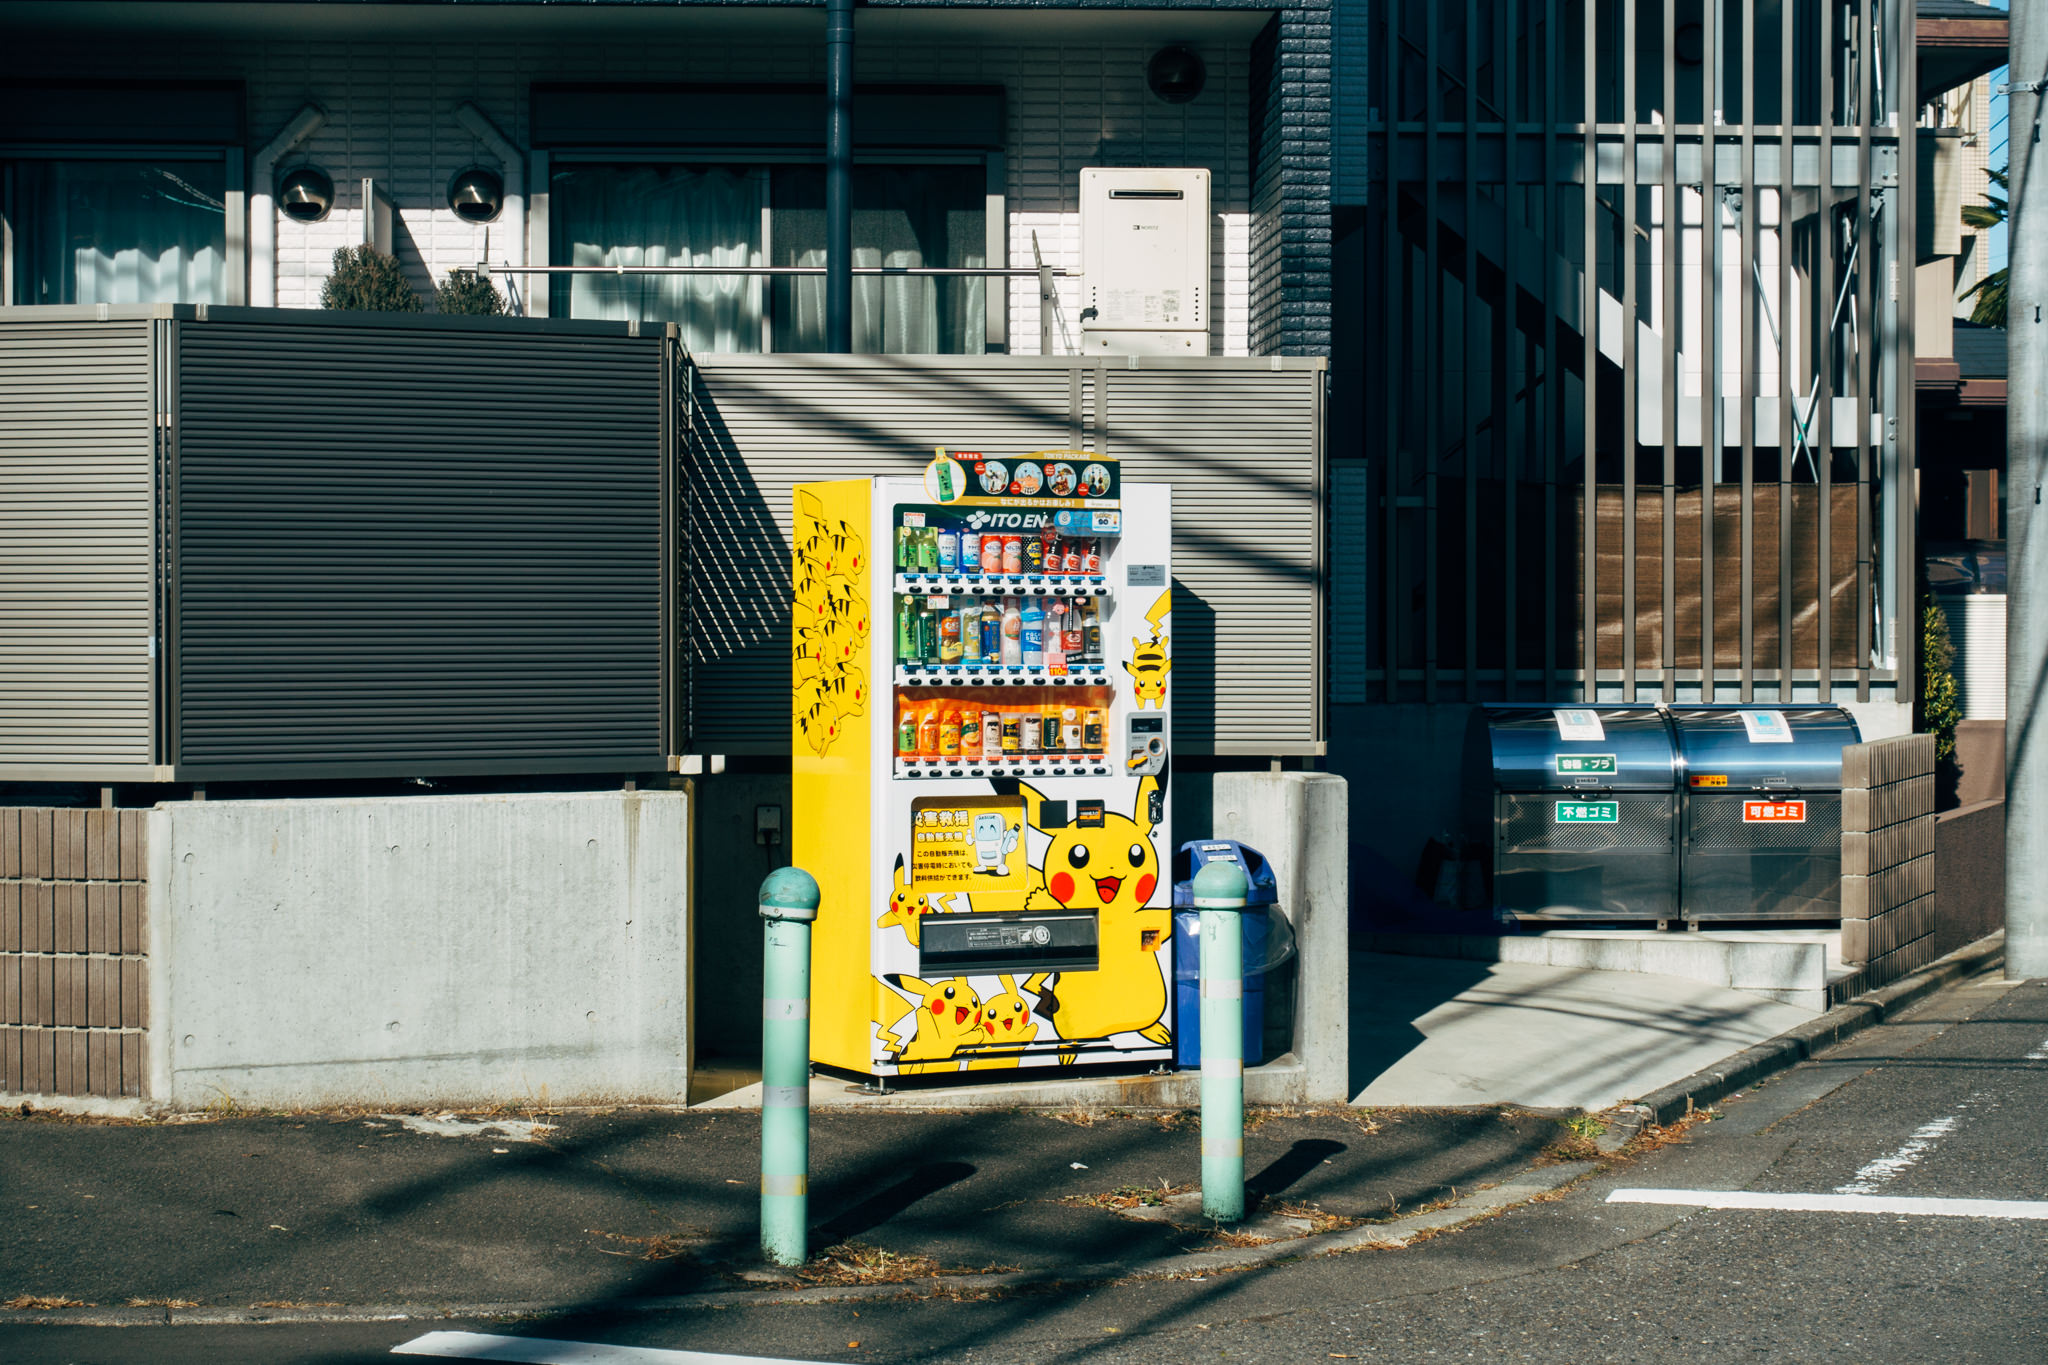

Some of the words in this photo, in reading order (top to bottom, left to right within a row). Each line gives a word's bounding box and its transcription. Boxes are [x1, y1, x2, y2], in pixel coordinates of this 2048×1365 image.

[990, 513, 1022, 529] ITO
[1022, 514, 1046, 529] EN
[1562, 806, 1611, 818] 不燃ゴミ
[1750, 805, 1798, 818] 可燃ゴミ
